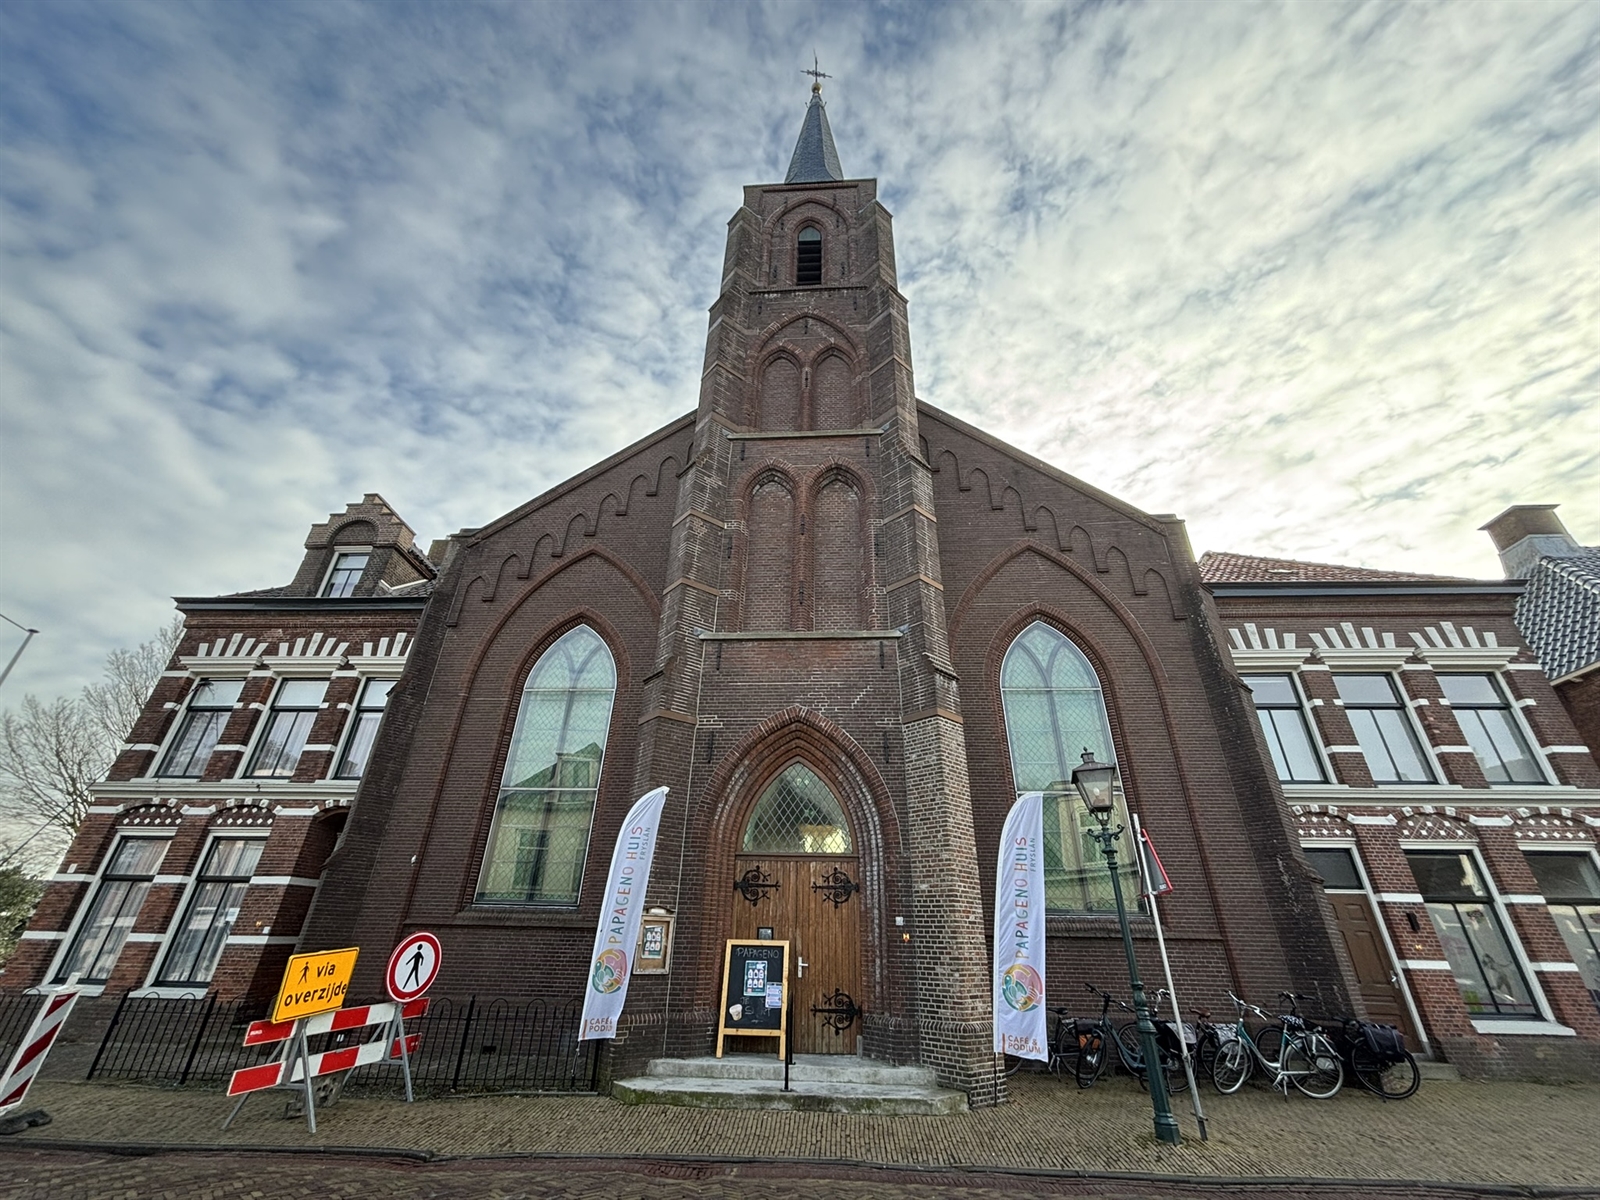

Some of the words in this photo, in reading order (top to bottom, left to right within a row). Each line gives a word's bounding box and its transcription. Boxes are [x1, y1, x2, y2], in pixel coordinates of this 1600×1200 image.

[1014, 836, 1028, 872] HUIS
[608, 866, 635, 944] PAPAGENO
[626, 826, 643, 860] HUIS
[1014, 878, 1030, 960] PAPAGENO
[736, 947, 779, 959] PAPAGENO
[317, 961, 336, 978] via
[284, 980, 347, 1007] overzijde
[1007, 1034, 1030, 1045] CAFÉ
[1008, 1042, 1042, 1054] PODIUM
